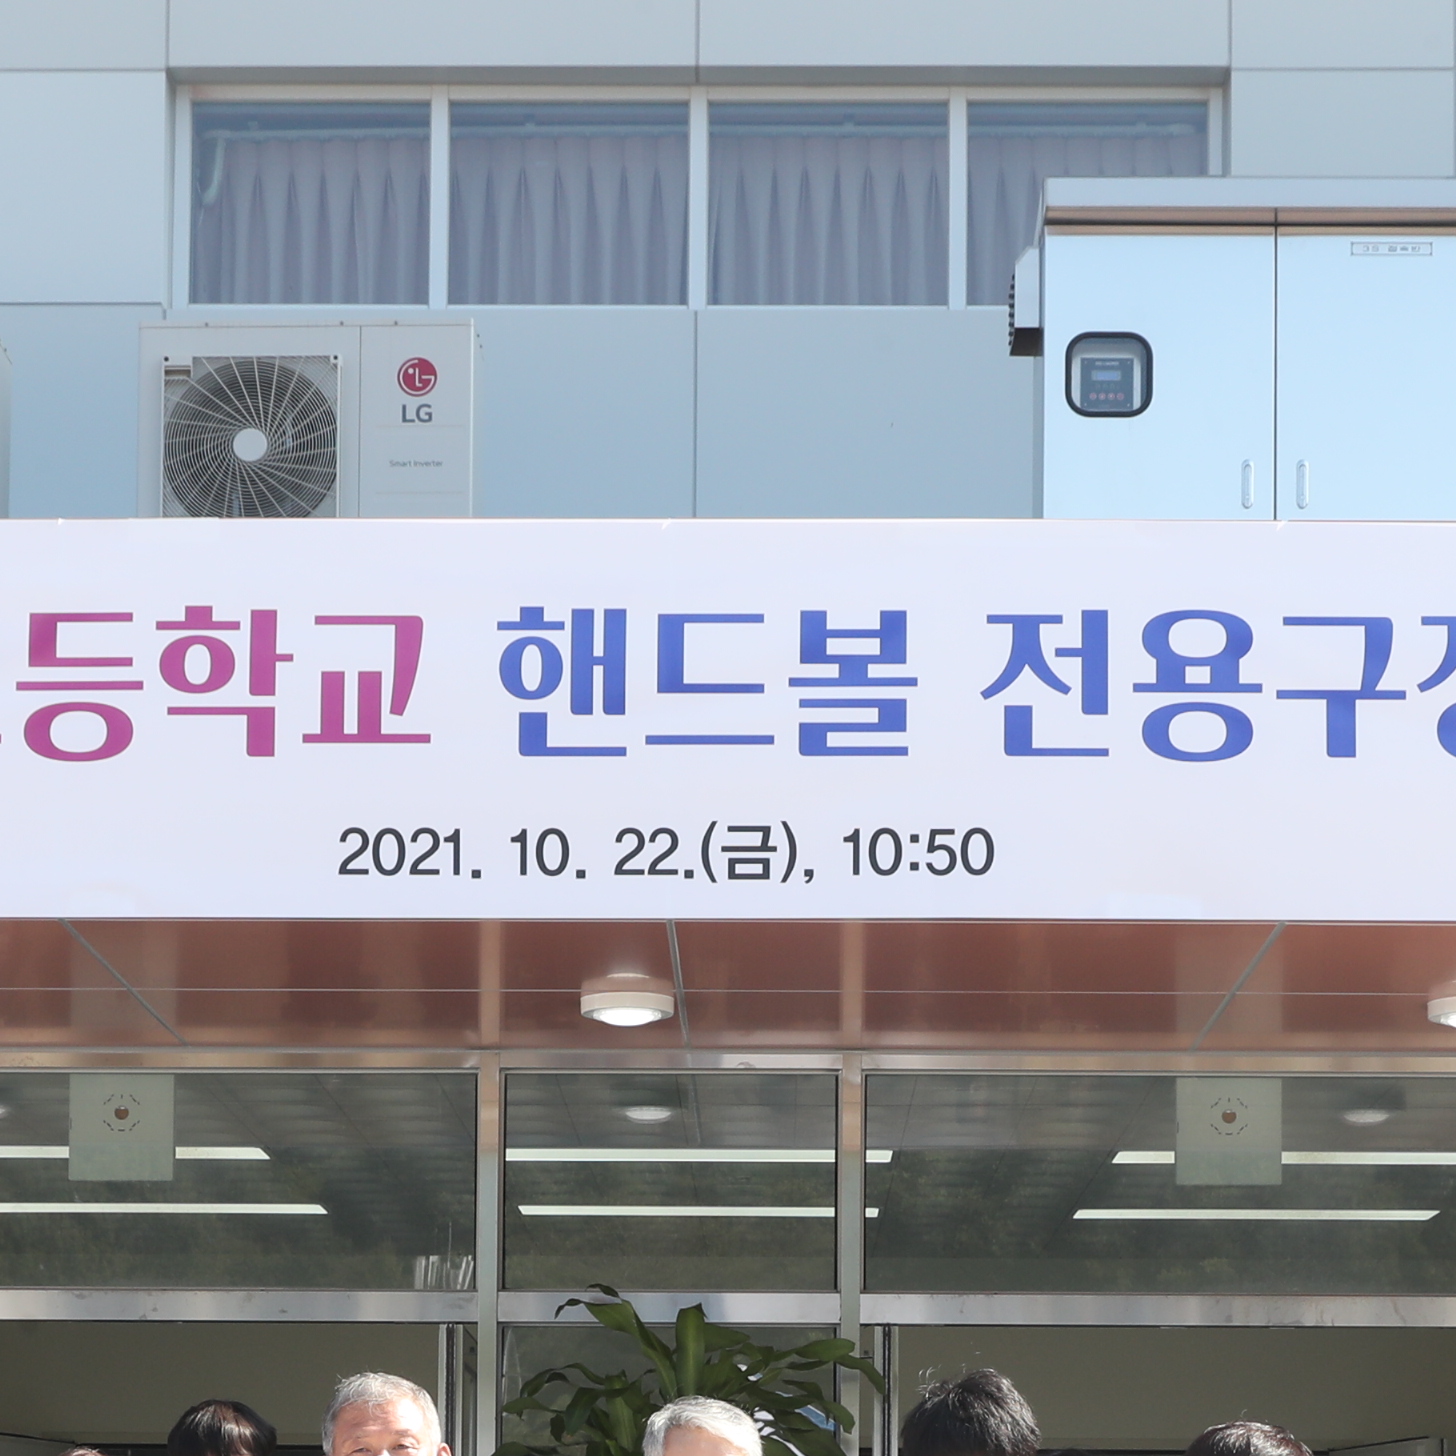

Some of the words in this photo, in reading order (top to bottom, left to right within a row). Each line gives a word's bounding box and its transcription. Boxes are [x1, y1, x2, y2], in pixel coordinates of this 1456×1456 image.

[402, 404, 433, 423] LG
[497, 605, 919, 759] 핸드볼
[338, 826, 483, 880] 2021.
[509, 826, 588, 880] 10.
[613, 820, 816, 884] 22.(금),
[842, 826, 996, 877] 10:50
